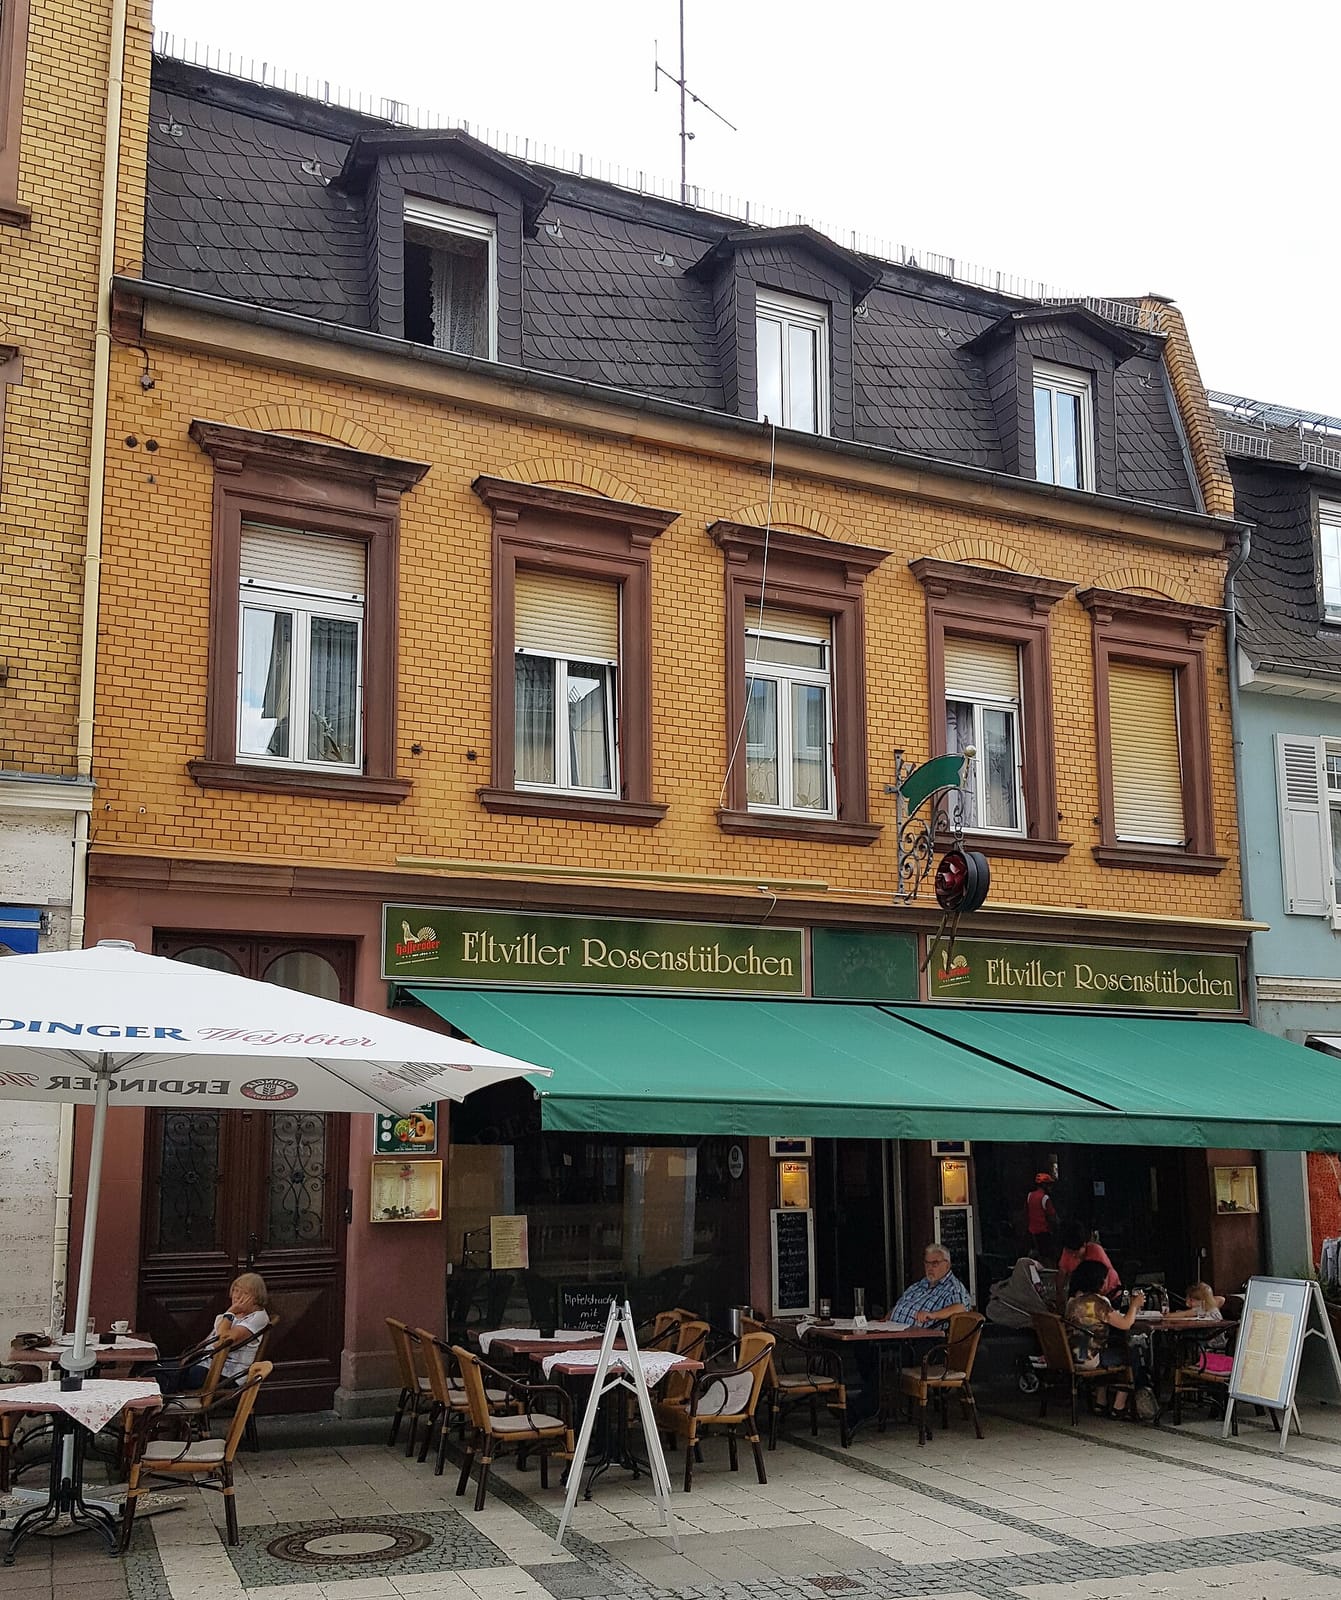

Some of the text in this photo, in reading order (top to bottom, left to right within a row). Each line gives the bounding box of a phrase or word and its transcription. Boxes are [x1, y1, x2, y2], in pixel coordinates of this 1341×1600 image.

[461, 930, 794, 976] Eltviller Rosenstübchen
[985, 958, 1066, 988] Eltviller
[1074, 964, 1234, 996] Rosenstübchen
[196, 1027, 377, 1048] Weißbier
[580, 1308, 599, 1318] mit
